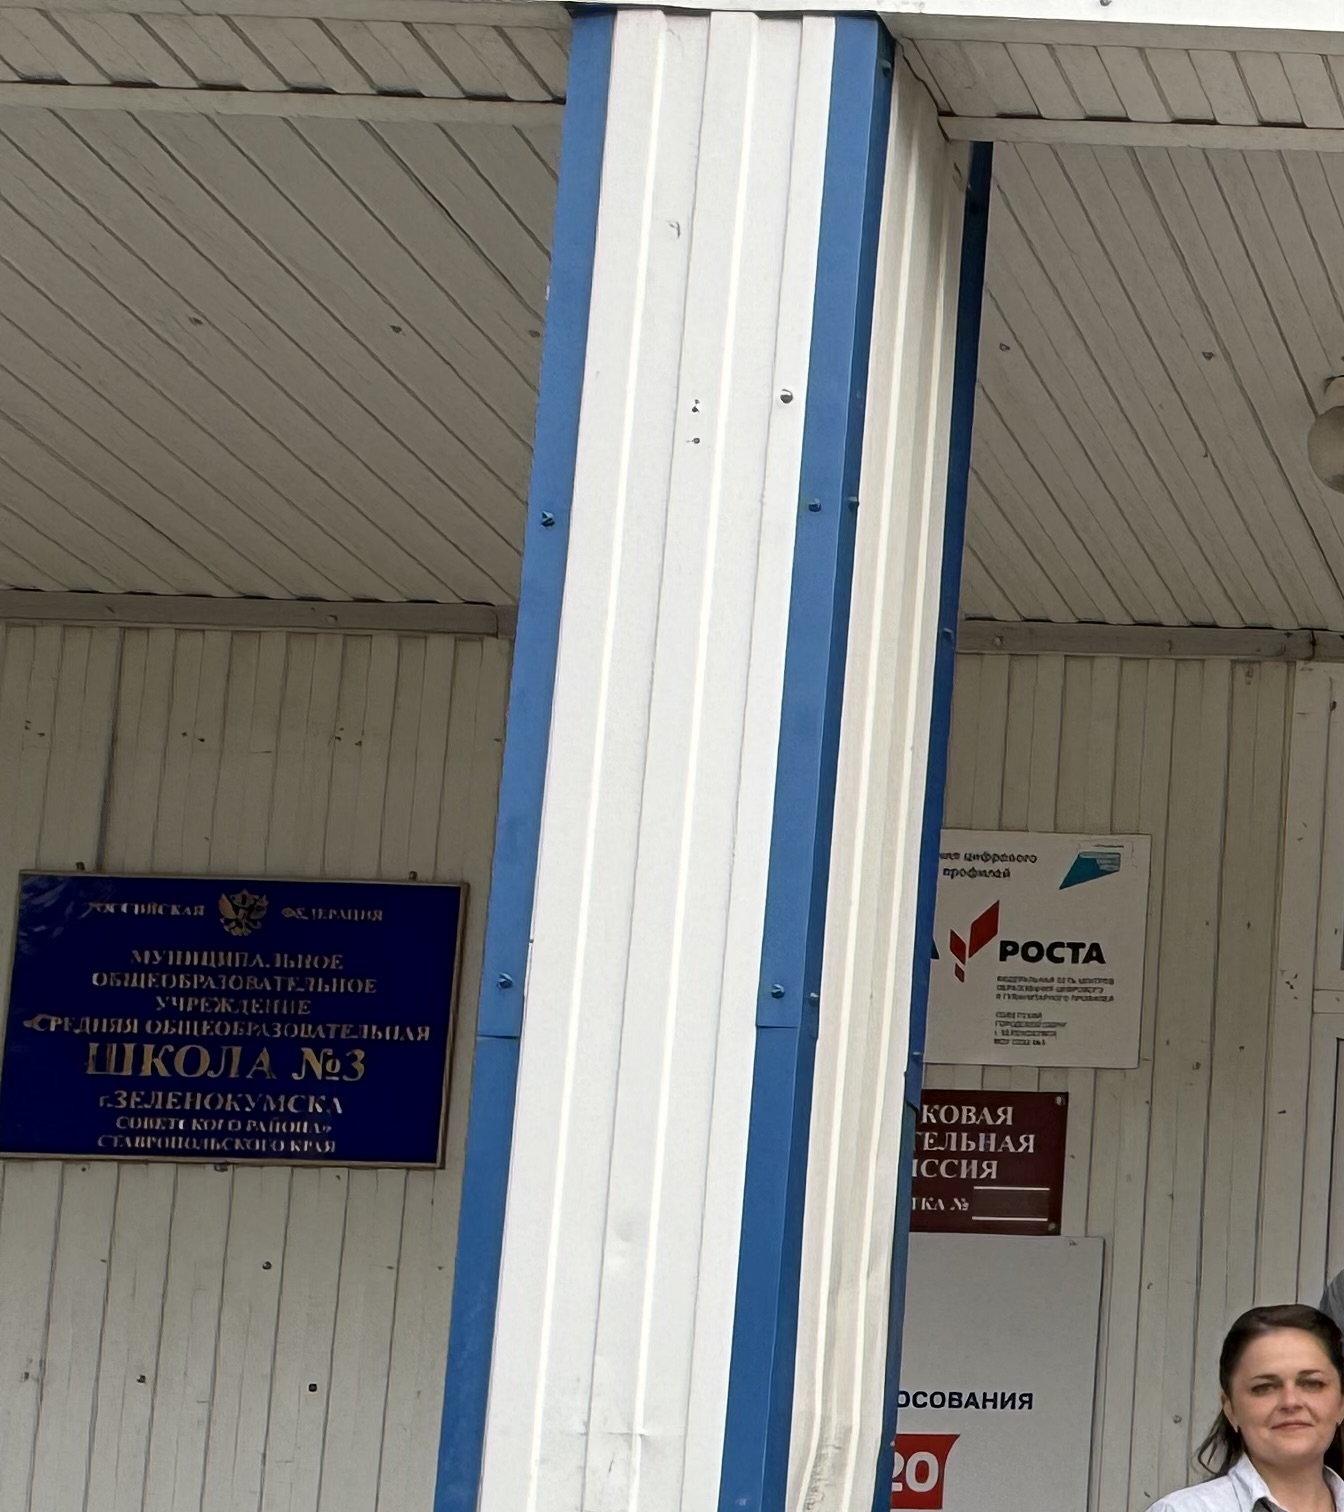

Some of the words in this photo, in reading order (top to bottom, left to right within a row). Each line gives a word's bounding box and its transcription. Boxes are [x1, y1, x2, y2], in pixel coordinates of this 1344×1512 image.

[132, 949, 344, 970] МУНИЦИПАЛЬНОЕ
[999, 939, 1106, 964] РОСТА
[91, 971, 378, 994] ОБЩЕОБРАЗОВАТЕЛЬНОЕ
[155, 995, 312, 1016] УЧРЕЖДЕНИЕ
[144, 1018, 431, 1042] ОБЩЕОБРАЗОВАТЕЛЬНАЯ
[85, 1041, 278, 1080] ШКОЛА
[291, 1046, 366, 1082] №3
[115, 1115, 242, 1132] СОВЕТСКОГО
[920, 1104, 1014, 1126] КОВАЯ
[96, 1134, 285, 1151] СТАВРОПОЛЬСКОГО
[290, 1139, 337, 1153] КРАЯ
